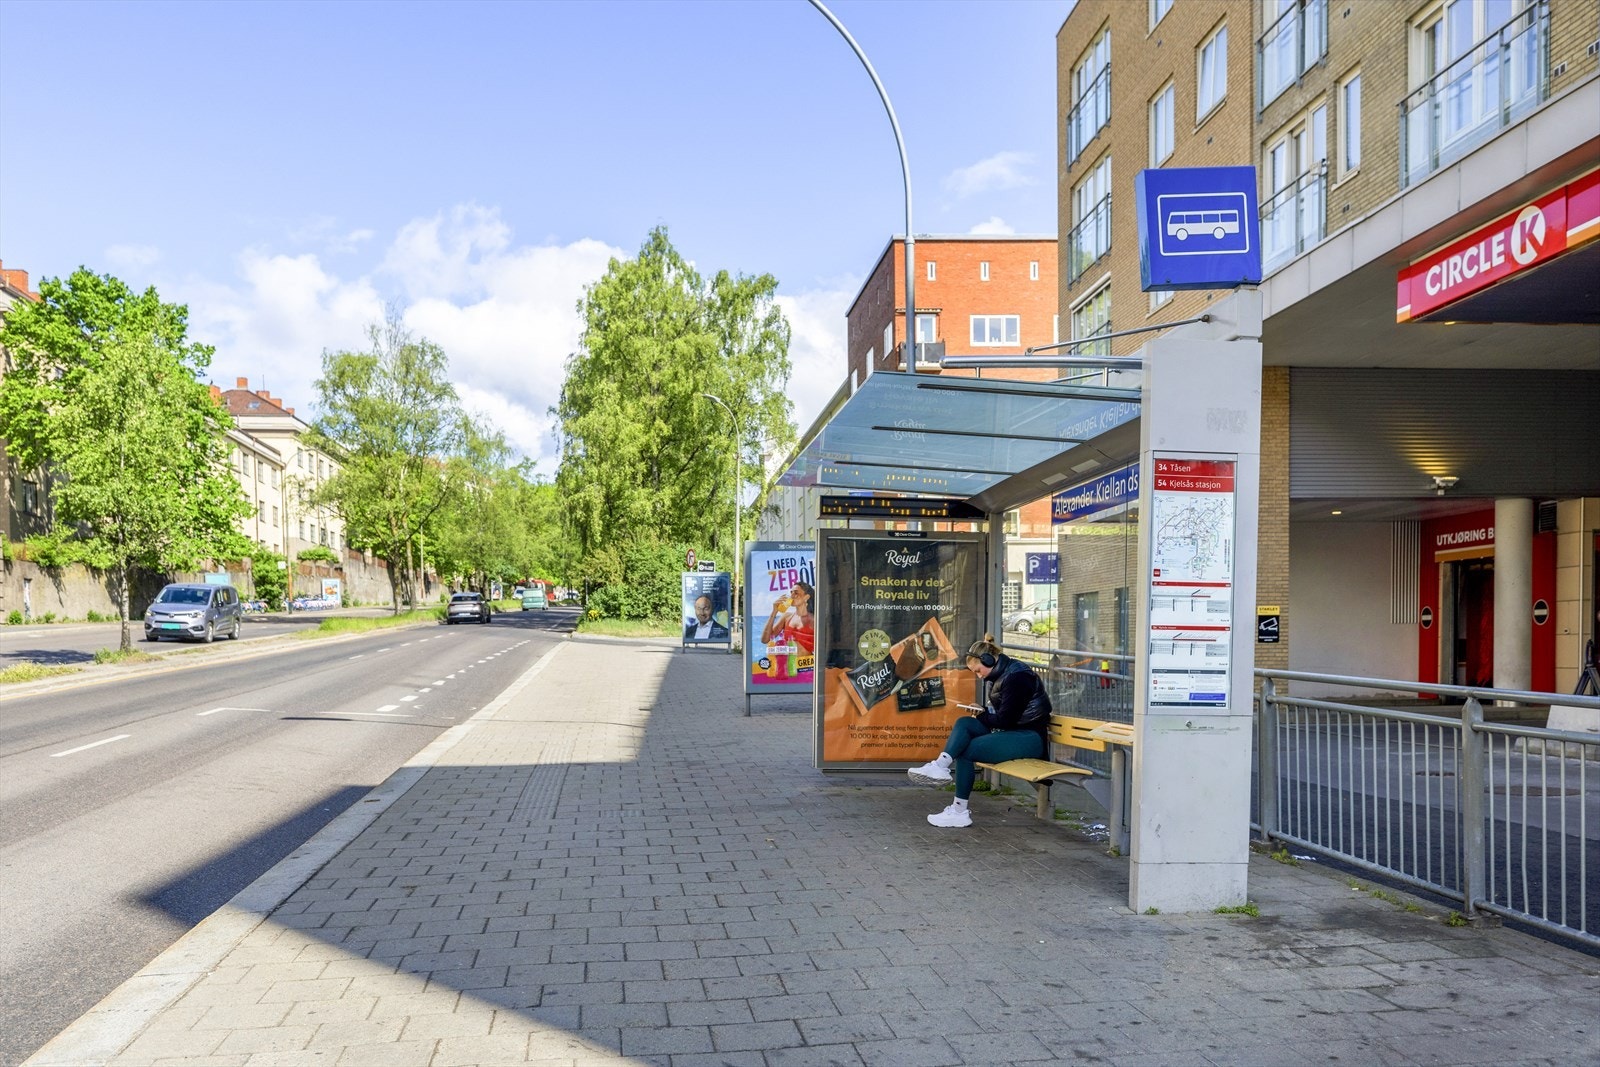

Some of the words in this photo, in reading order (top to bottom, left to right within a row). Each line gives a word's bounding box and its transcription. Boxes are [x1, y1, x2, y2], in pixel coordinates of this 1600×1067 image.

[1425, 231, 1505, 296] CIRCLE
[1170, 463, 1191, 472] Tåsen
[1157, 479, 1167, 487] 54
[1169, 479, 1194, 489] Kjelsås
[1195, 481, 1221, 490] stasjon
[1055, 487, 1094, 517] Alexander
[1436, 528, 1486, 546] UTKJØRING
[1487, 527, 1494, 539] B
[767, 560, 771, 570] I
[774, 557, 797, 570] NEED
[800, 556, 807, 566] A
[885, 549, 921, 568] Royal
[1029, 559, 1040, 574] P
[861, 576, 908, 587] Smaken
[909, 579, 924, 587] av
[925, 577, 944, 588] det
[875, 589, 915, 602] Royale
[916, 590, 930, 600] liv
[865, 603, 902, 611] Royal-kortet
[865, 632, 885, 641] FINN
[865, 650, 886, 659] VINN
[797, 658, 814, 667] GREA
[857, 663, 891, 689] Royal
